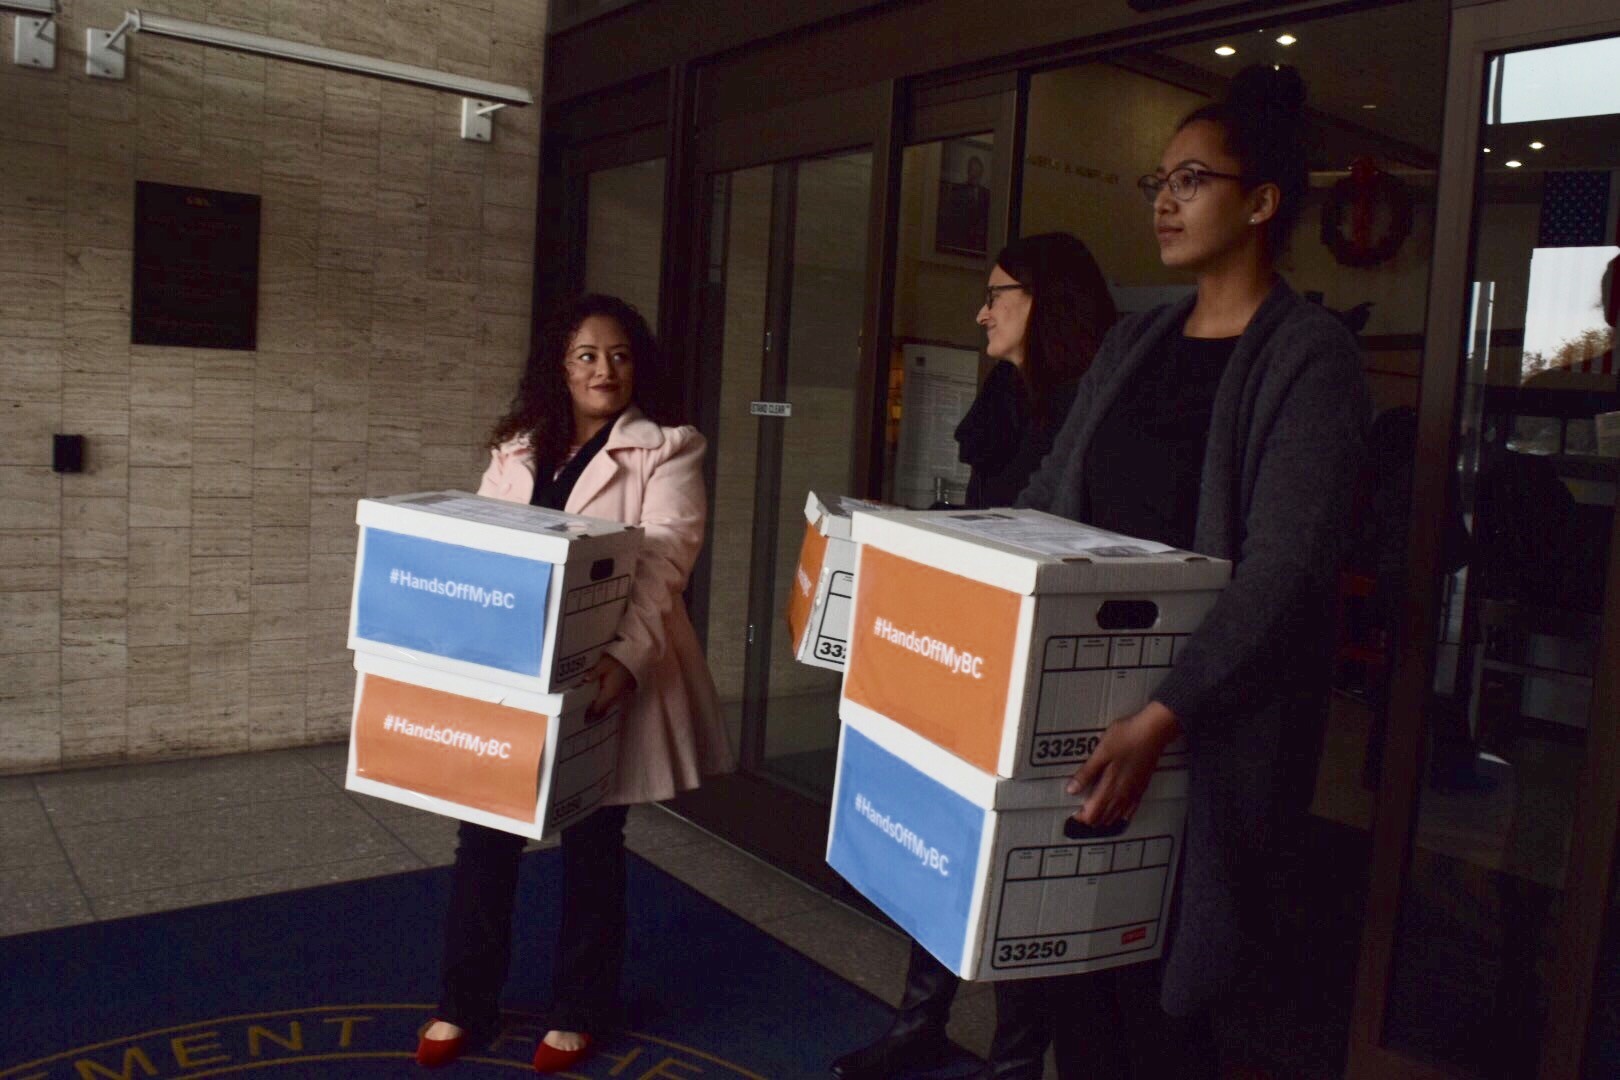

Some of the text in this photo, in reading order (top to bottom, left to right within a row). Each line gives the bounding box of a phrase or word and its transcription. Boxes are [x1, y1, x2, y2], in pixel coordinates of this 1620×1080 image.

[389, 568, 515, 609] #HandsOffMyBC
[820, 641, 847, 659] 33
[873, 616, 984, 679] #HandsOffMyBC
[383, 714, 512, 759] #HandsOffMyBC
[854, 792, 950, 877] #HandsOffMyBC
[998, 939, 1067, 962] 33250
